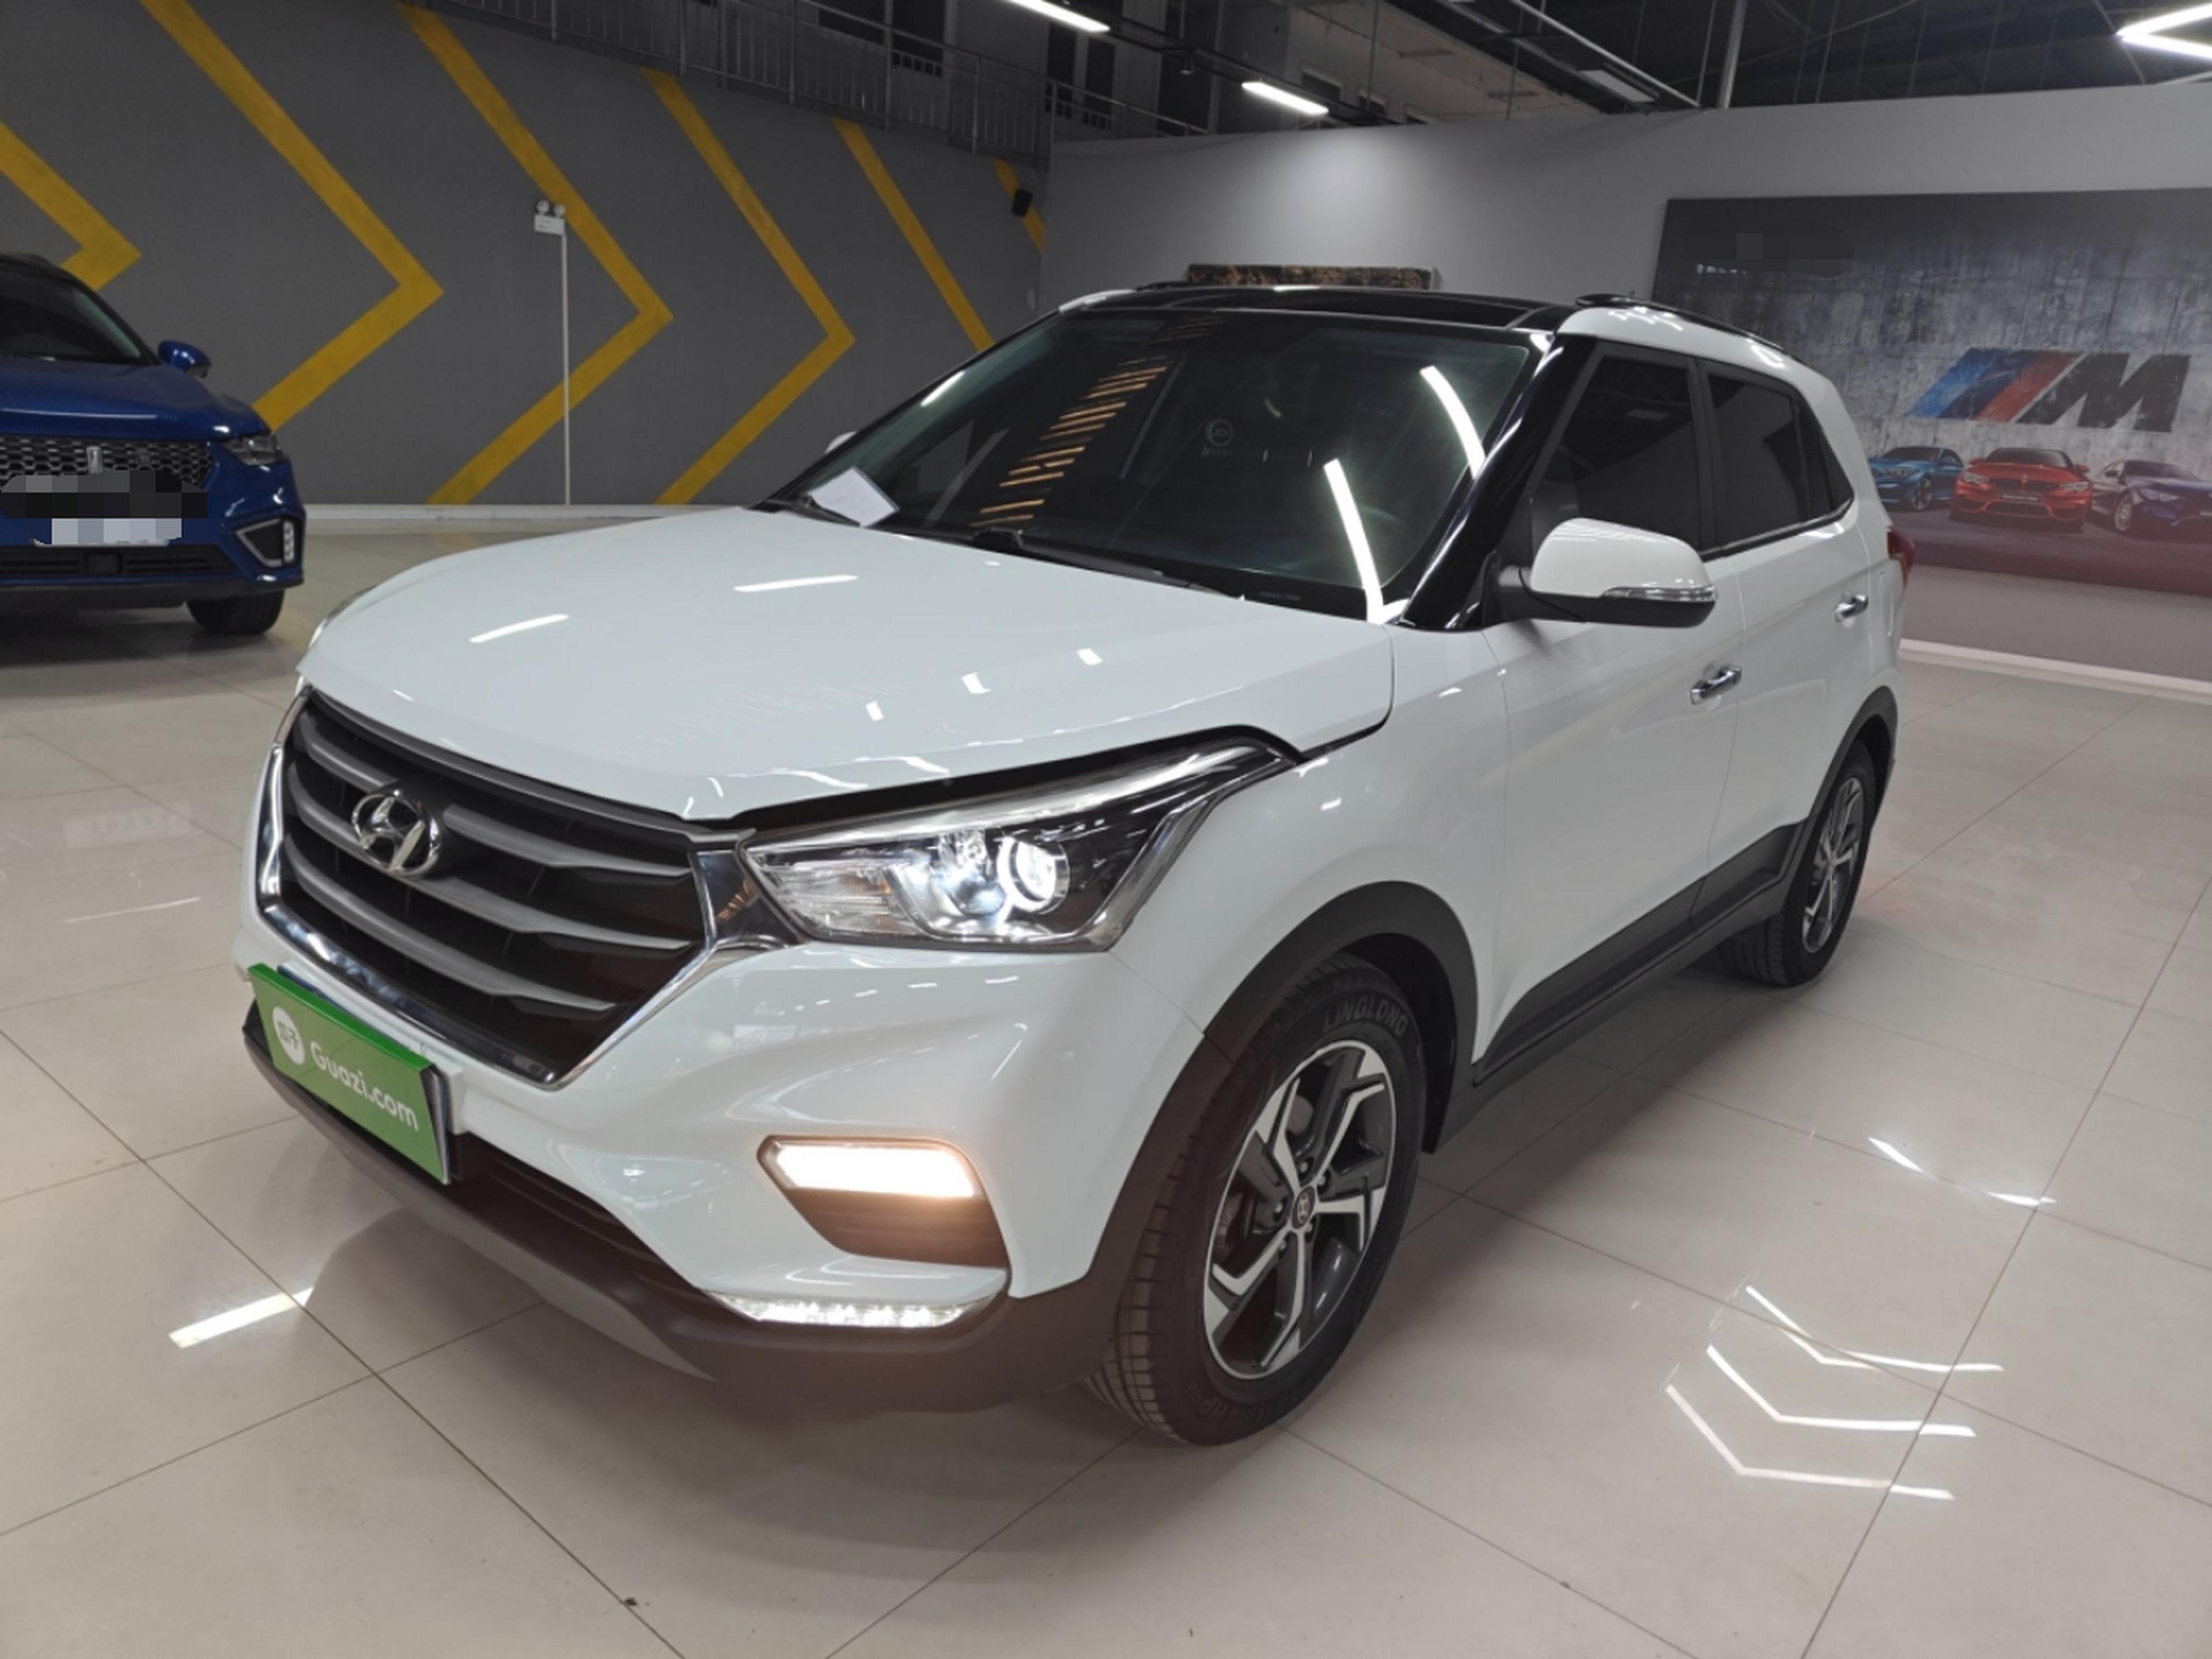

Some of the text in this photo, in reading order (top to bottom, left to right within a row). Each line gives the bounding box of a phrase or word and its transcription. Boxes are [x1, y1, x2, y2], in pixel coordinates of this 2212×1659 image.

[2016, 352, 2191, 433] M
[1322, 994, 1409, 1037] LINGLONG
[310, 1040, 419, 1131] Guazi.com
